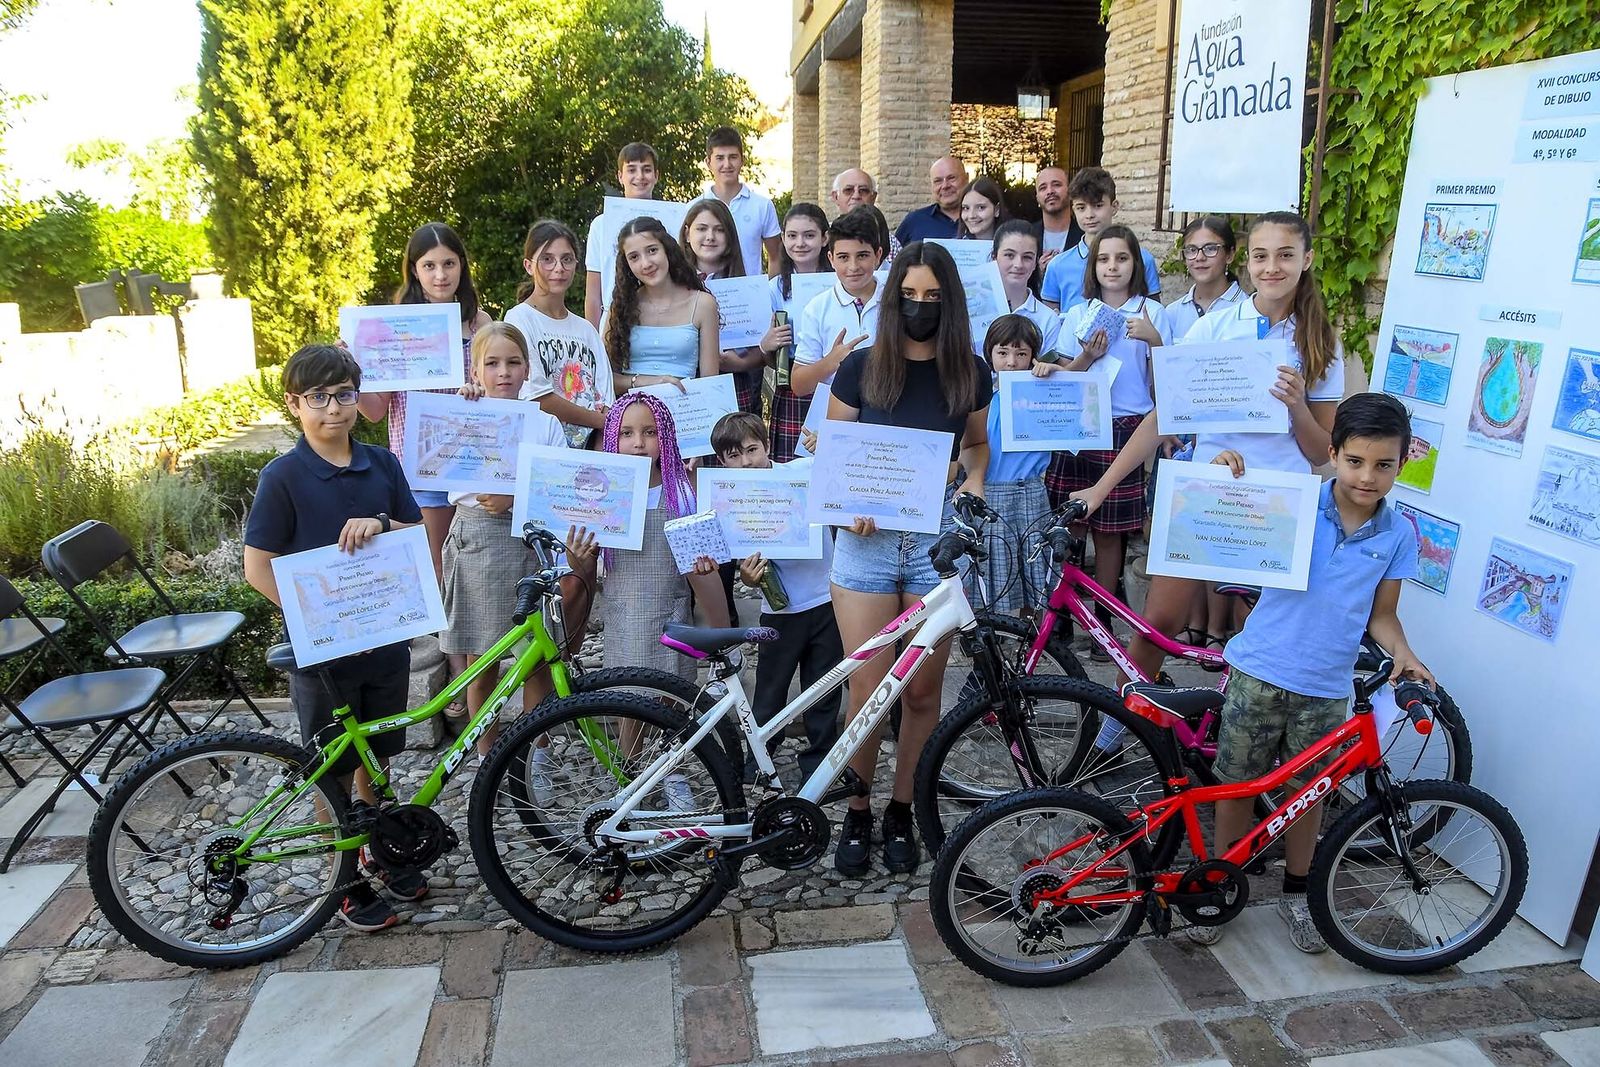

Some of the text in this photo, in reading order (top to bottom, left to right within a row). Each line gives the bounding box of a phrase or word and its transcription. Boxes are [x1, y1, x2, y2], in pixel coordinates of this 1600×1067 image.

[1201, 11, 1242, 41] fundación
[1184, 33, 1245, 89] Agua
[1537, 72, 1600, 88] XVII CONCURS
[1182, 62, 1292, 123] Granada
[1544, 91, 1591, 106] DE DIBUJO
[1532, 128, 1586, 140] MODALIDAD
[1559, 149, 1565, 159] Y
[1436, 185, 1496, 195] PRIMER PREMIO
[1499, 310, 1536, 324] ACCÉSITS
[1167, 551, 1190, 560] IDEAL
[312, 634, 335, 646] IDEAL
[829, 681, 893, 771] B-PRO
[444, 696, 509, 774] B-PRO
[1266, 776, 1333, 837] B-PRO
